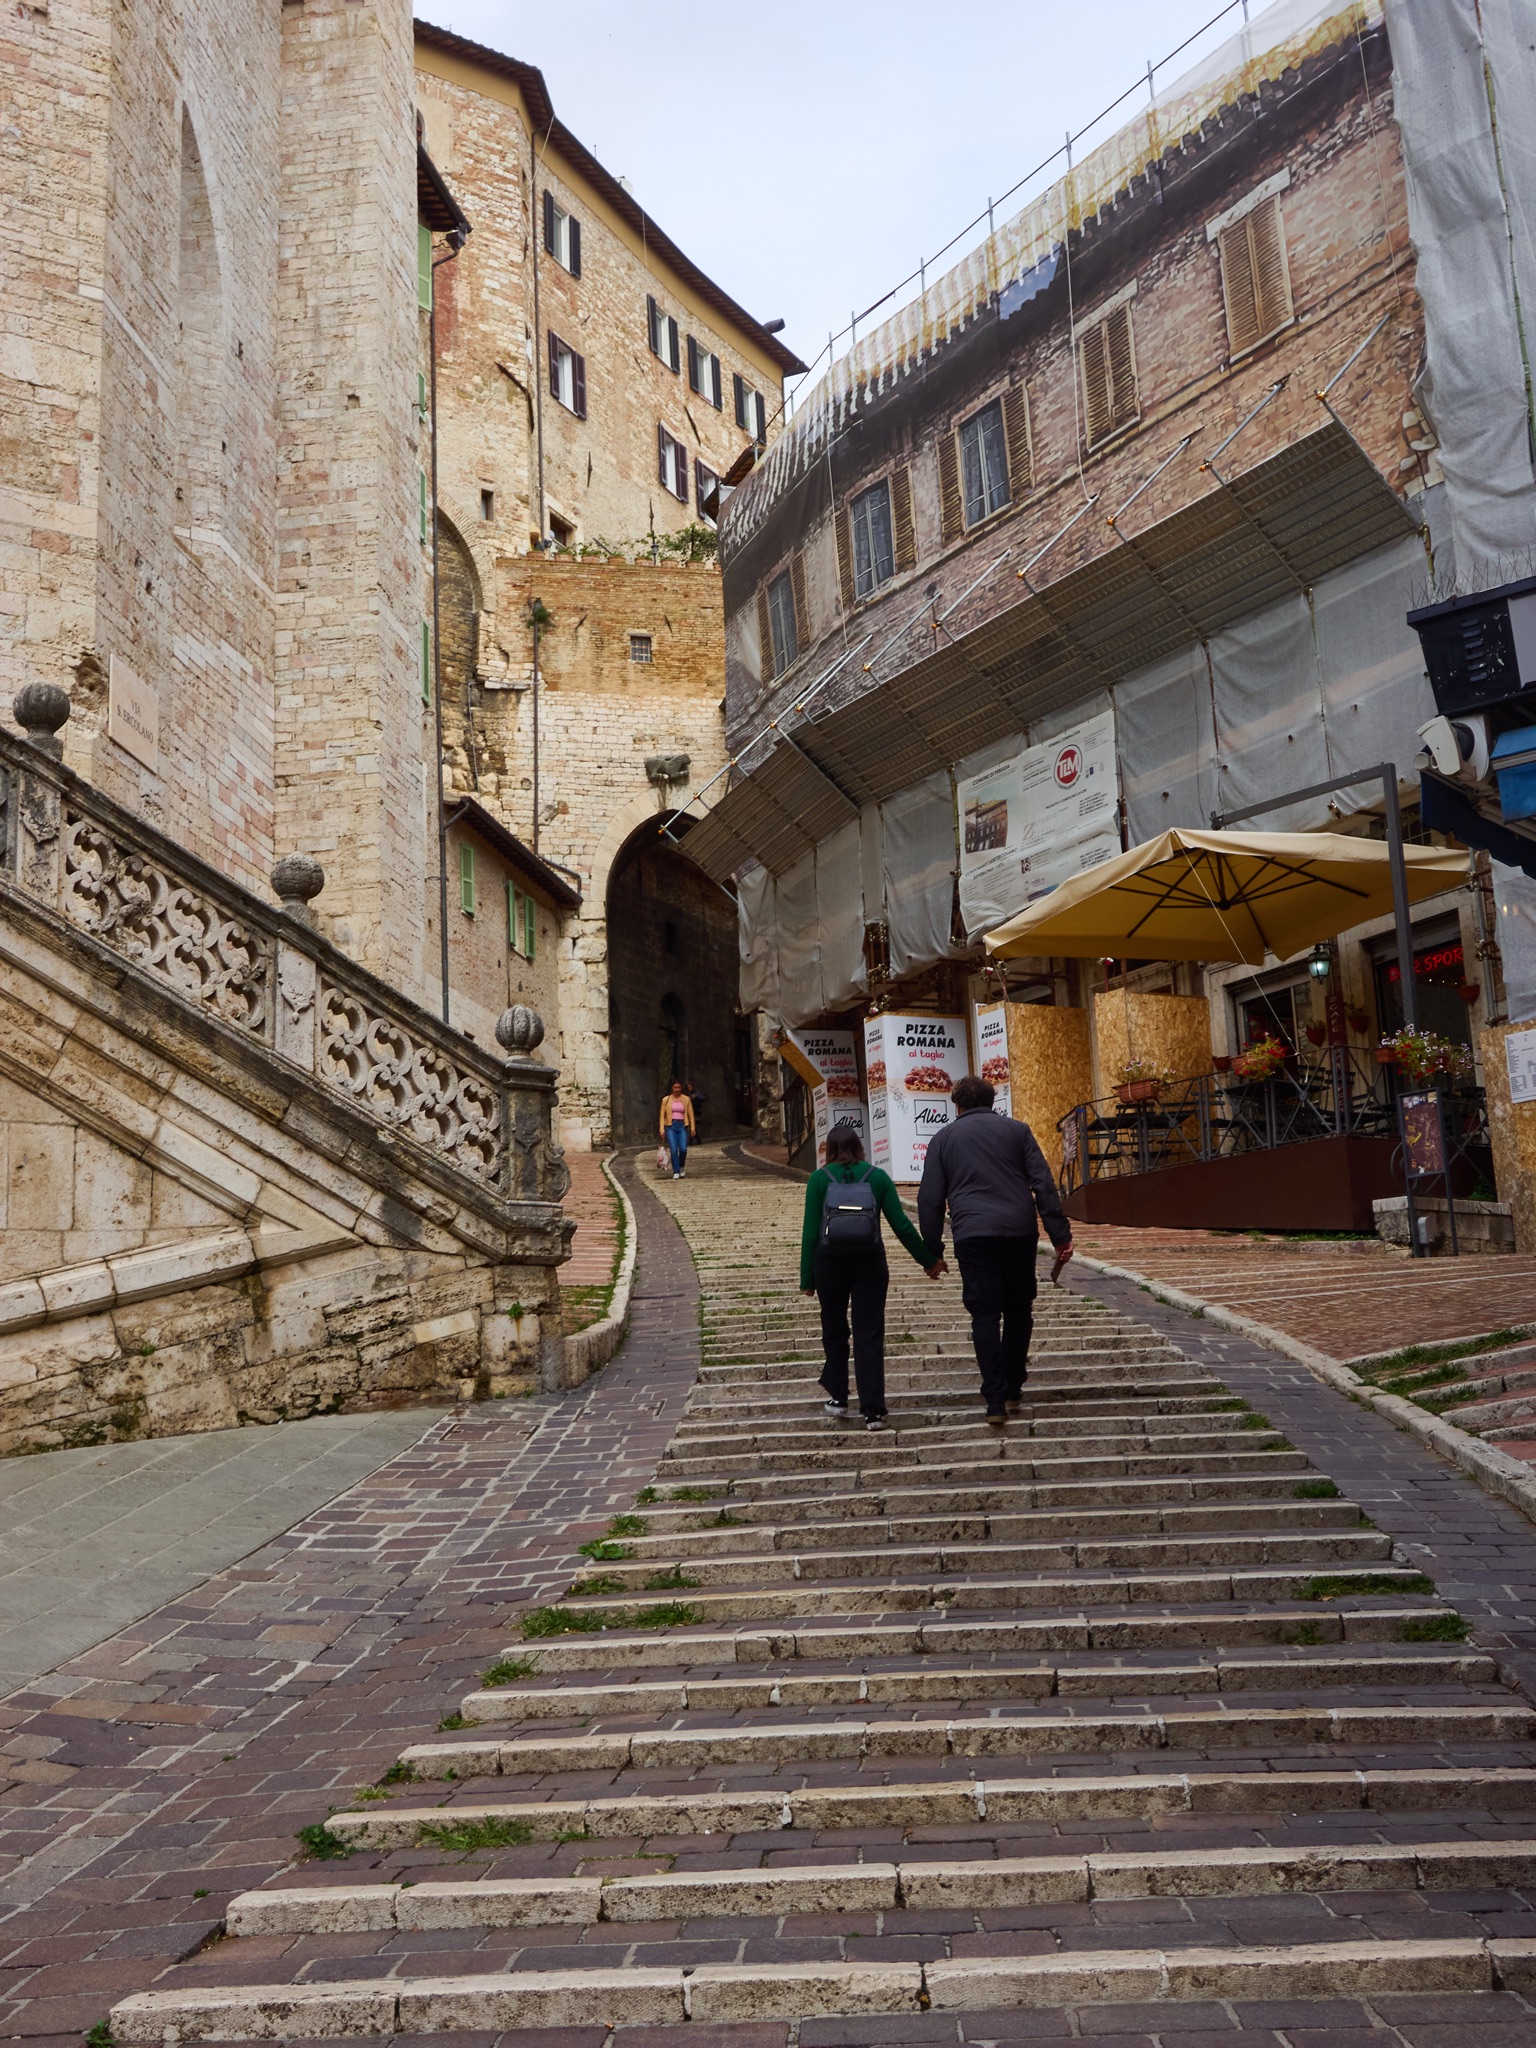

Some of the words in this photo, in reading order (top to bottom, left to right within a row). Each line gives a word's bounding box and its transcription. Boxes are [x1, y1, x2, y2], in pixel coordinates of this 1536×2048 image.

[131, 699, 141, 717] VIA
[123, 709, 153, 744] ERCOLANO
[1058, 754, 1079, 779] TLM
[972, 774, 990, 786] COMUNE
[905, 1023, 946, 1036] PIZZA
[984, 1021, 1000, 1032] PIZZA
[981, 1027, 1004, 1039] ROMANA
[804, 1039, 835, 1048] PIZZA
[897, 1036, 956, 1049] ROMANA
[808, 1047, 852, 1056] ROMANA
[909, 1049, 917, 1058] al
[920, 1049, 945, 1062] taglio
[820, 1059, 827, 1067] al
[830, 1058, 854, 1068] taglio
[913, 1107, 949, 1124] Alice
[834, 1115, 865, 1129] Alice
[912, 1143, 929, 1151] CON
[910, 1164, 921, 1172] tel.
